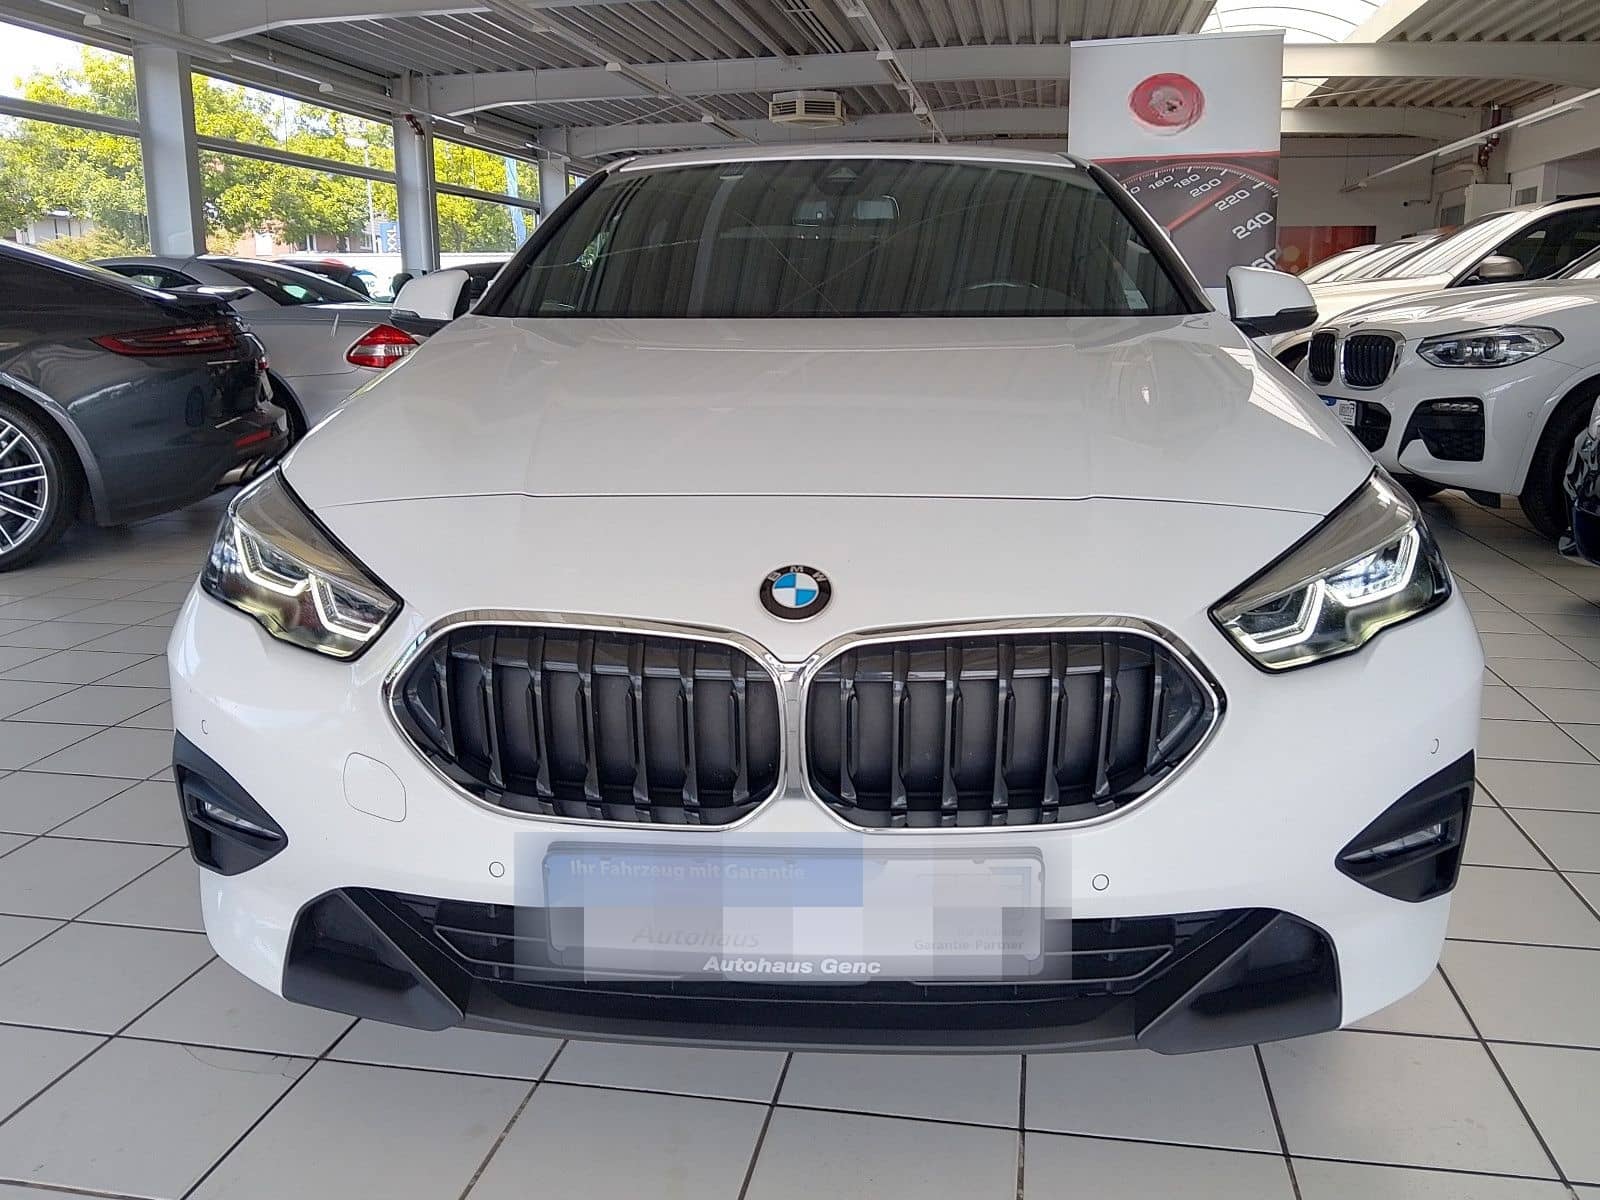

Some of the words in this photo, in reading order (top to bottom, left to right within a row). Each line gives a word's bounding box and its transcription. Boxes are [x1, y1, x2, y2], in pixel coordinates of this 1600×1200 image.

[1148, 175, 1174, 190] 160
[1174, 174, 1201, 189] 180
[1189, 178, 1222, 197] 200
[1214, 189, 1251, 211] 220
[1232, 212, 1274, 239] 240
[768, 566, 827, 582] BMW
[570, 859, 596, 876] Ihr
[600, 860, 685, 881] Fahrzeug
[690, 862, 721, 878] mit
[726, 863, 806, 881] Garantie
[632, 927, 760, 948] Autohaus
[703, 956, 813, 974] Autohaus
[820, 957, 881, 975] Genc
